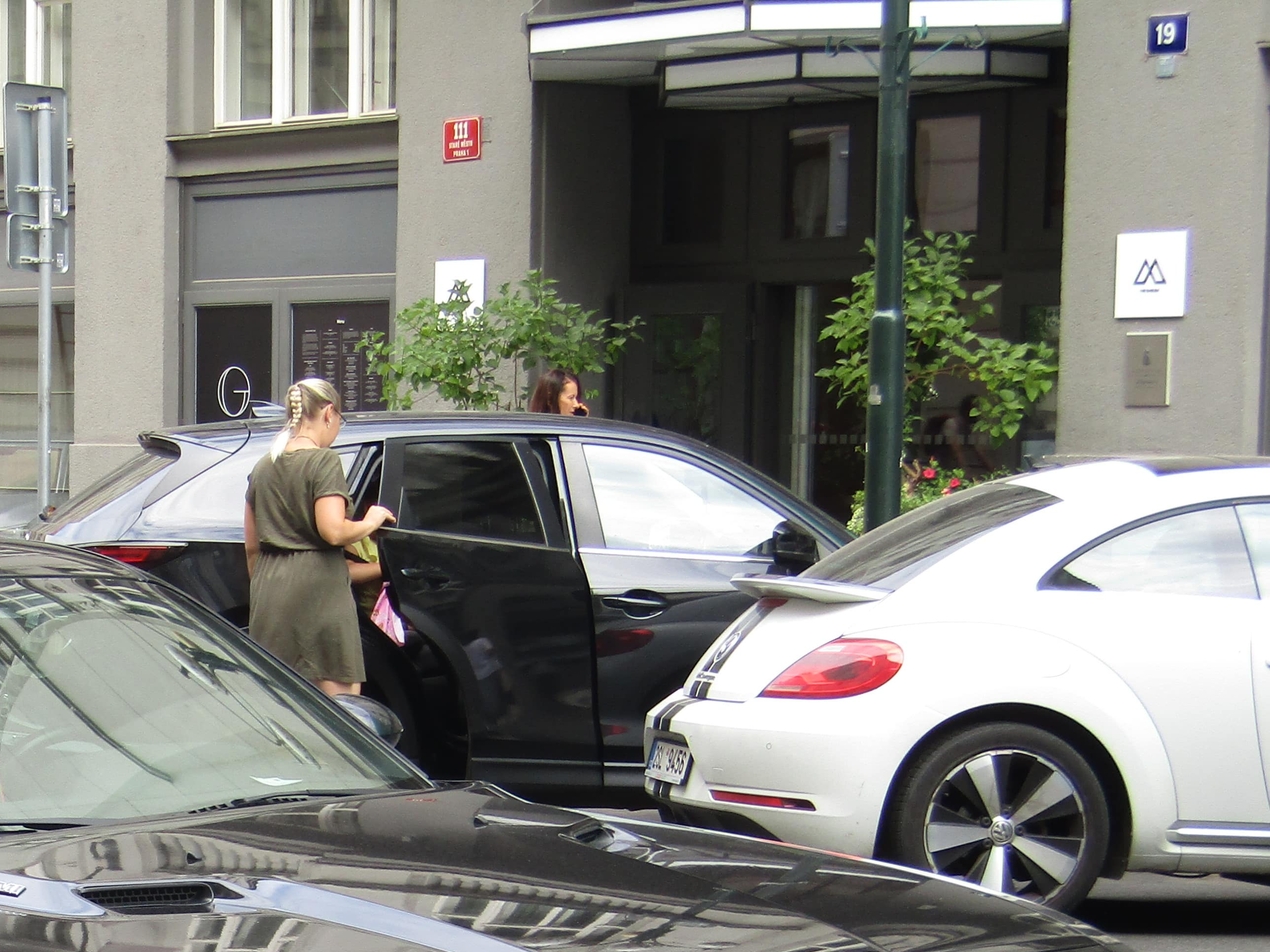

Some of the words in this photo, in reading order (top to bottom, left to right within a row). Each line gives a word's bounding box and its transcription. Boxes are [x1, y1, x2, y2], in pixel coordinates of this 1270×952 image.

[1155, 22, 1176, 46] 19
[453, 121, 469, 140] 111
[217, 366, 251, 418] G
